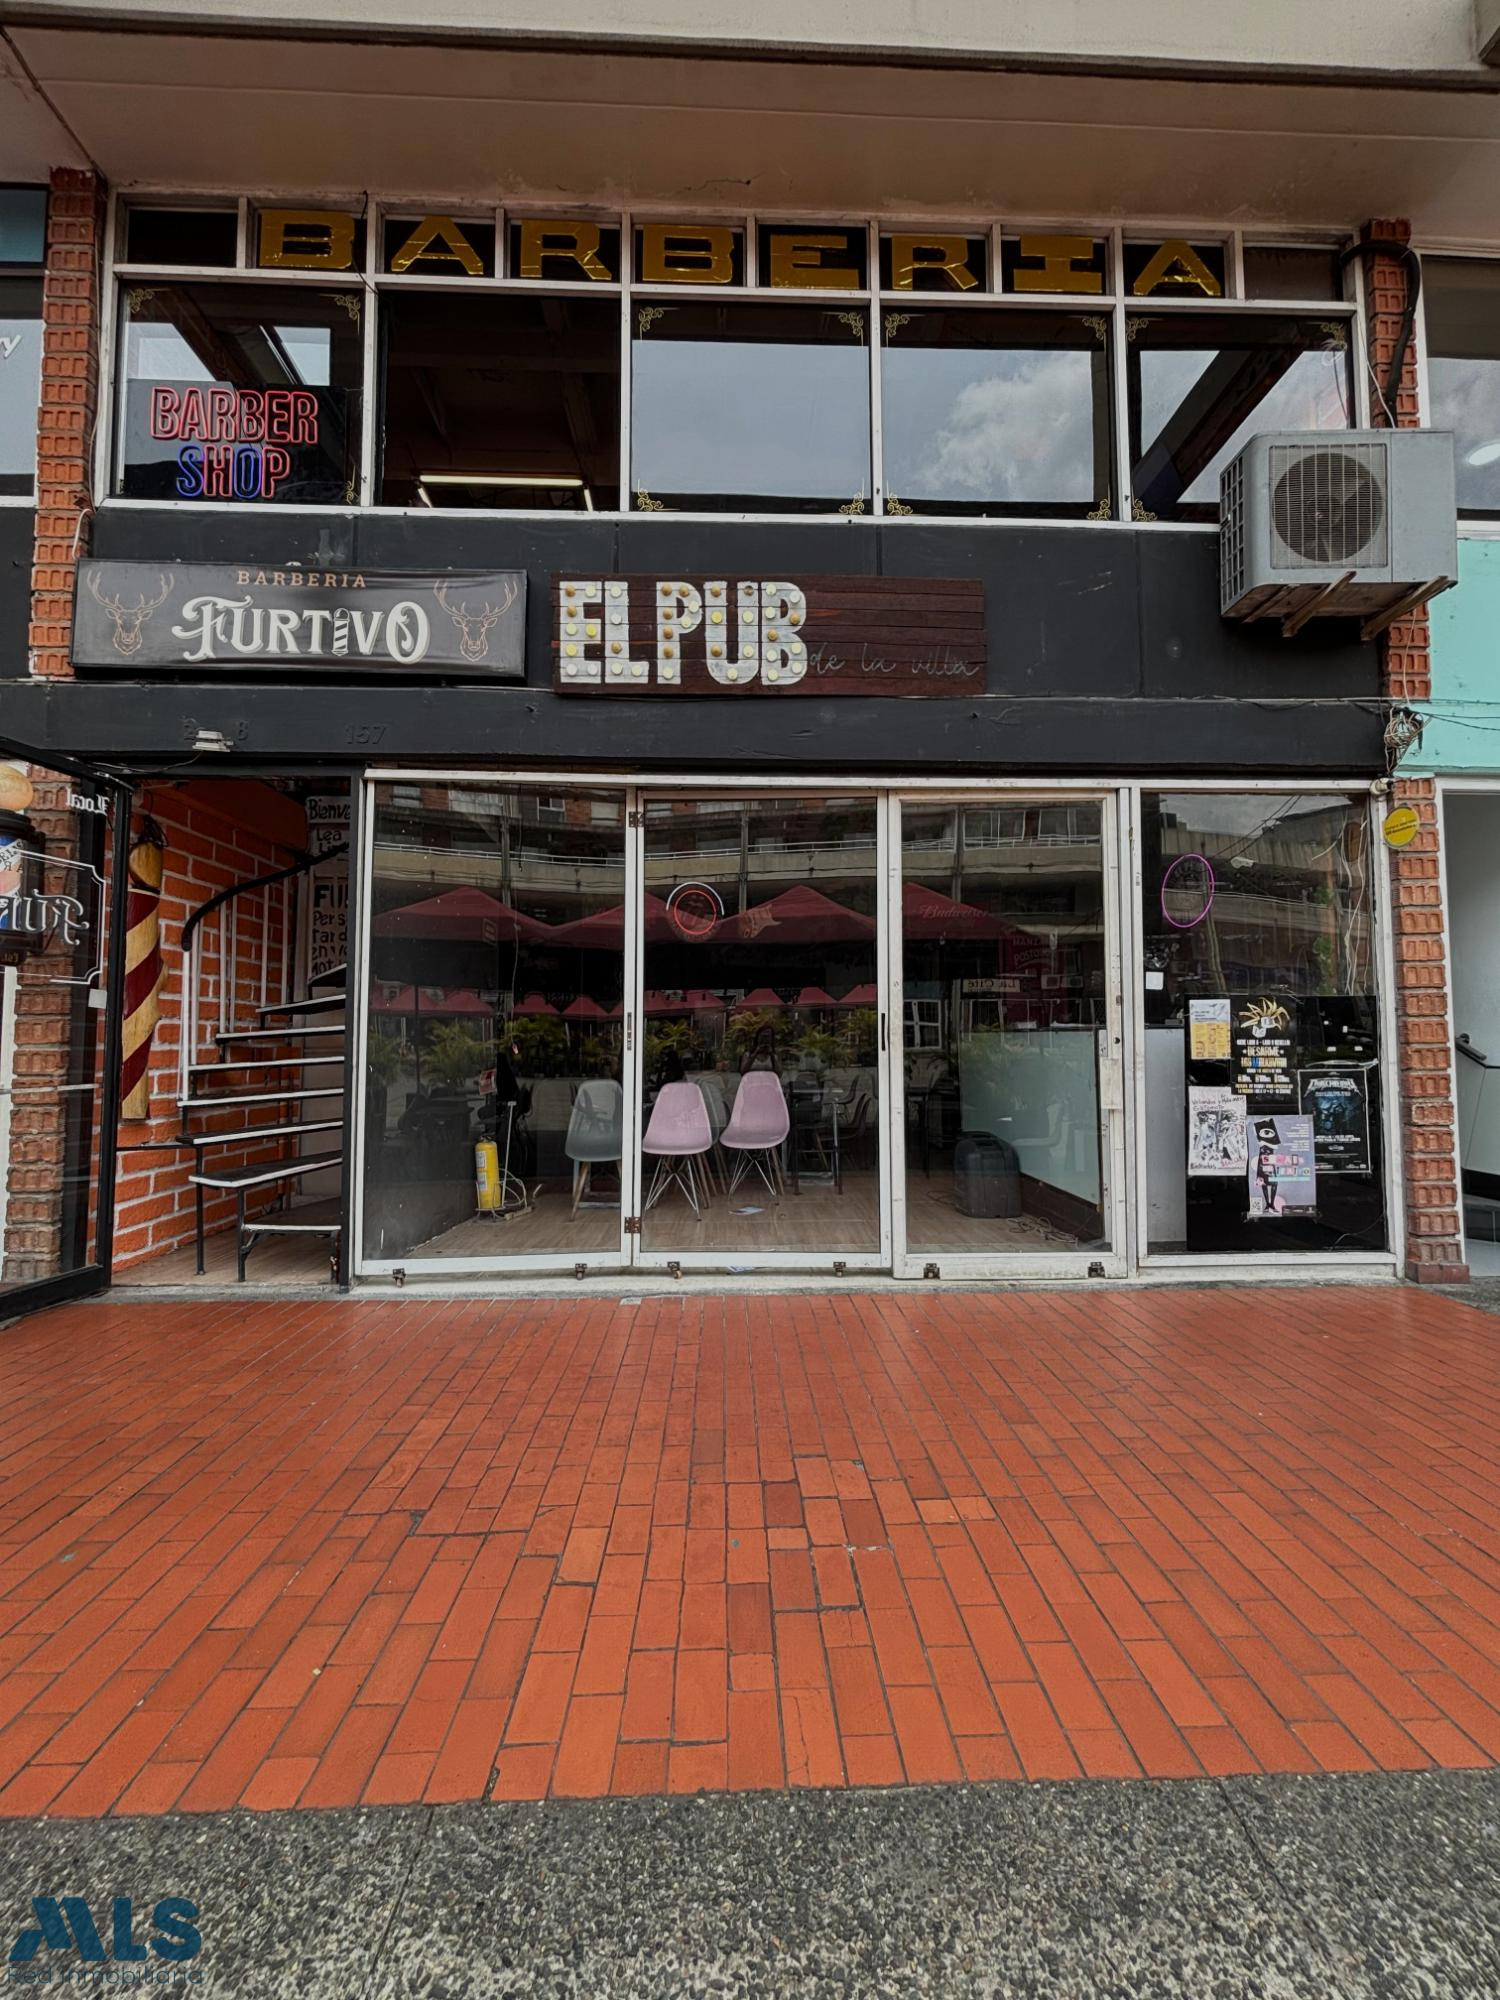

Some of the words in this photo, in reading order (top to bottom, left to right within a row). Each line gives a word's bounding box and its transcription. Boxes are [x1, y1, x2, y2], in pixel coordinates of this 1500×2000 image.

[258, 208, 1222, 297] BARBERIA
[149, 386, 319, 444] BARBER
[175, 444, 291, 498] SHOP
[236, 569, 367, 589] BARBERIA
[171, 593, 431, 664] FURTIVO
[809, 642, 846, 675] de
[861, 642, 897, 673] la
[911, 644, 983, 677] villa
